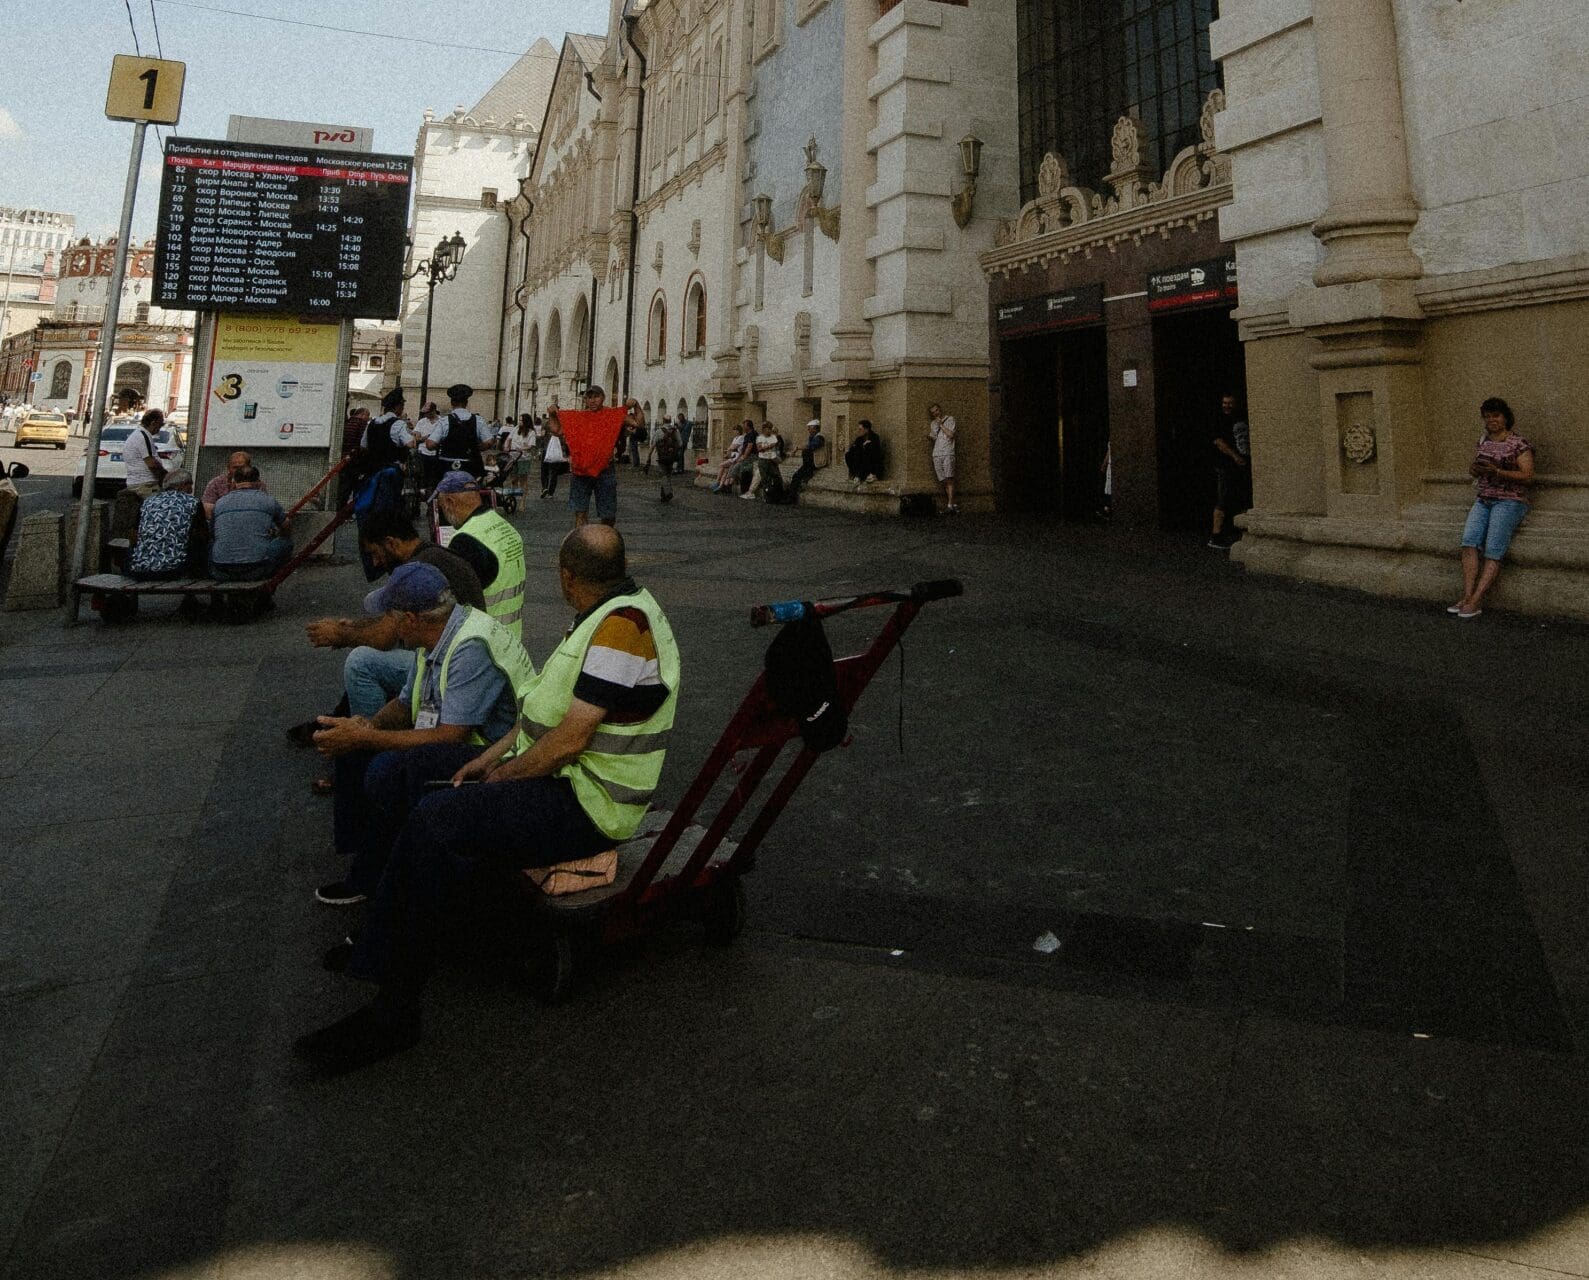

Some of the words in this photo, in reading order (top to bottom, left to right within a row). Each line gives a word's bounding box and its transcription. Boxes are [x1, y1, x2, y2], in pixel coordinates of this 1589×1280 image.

[139, 69, 158, 109] 1
[169, 144, 211, 154] Прибытие
[220, 149, 274, 160] отправление
[275, 153, 308, 162] поездов
[171, 157, 193, 165] Поезд
[223, 161, 255, 170] Маршрут
[256, 164, 296, 172] следования
[322, 168, 341, 177] Приб
[370, 172, 385, 181] Путь
[316, 157, 360, 167] Московское
[362, 162, 385, 170] время
[386, 162, 408, 170] 12:51
[196, 177, 220, 187] фирм
[221, 179, 248, 187] Анапа
[255, 181, 288, 190] Москва
[320, 186, 340, 194] 13:30
[199, 168, 219, 176] скор
[222, 169, 255, 178] Москва
[262, 172, 298, 182] Улан-Удэ
[347, 179, 367, 187] 13:10
[197, 188, 217, 196] скор
[220, 188, 259, 198] Воронеж
[266, 192, 298, 200] Москва
[319, 196, 340, 204] 13:53
[196, 197, 216, 205] скор
[219, 198, 251, 208] Липецк
[258, 200, 290, 209] Москва
[318, 205, 339, 213] 14:10
[169, 214, 184, 222] 119
[194, 217, 214, 225] скор
[217, 217, 252, 226] Саранск
[260, 219, 292, 229] Москва
[316, 223, 337, 232] 14:25
[195, 207, 215, 215] скор
[218, 208, 250, 217] Москва
[258, 210, 290, 220] Липецк
[342, 216, 363, 224] 14:20
[170, 224, 180, 232] 30
[190, 226, 215, 234] фирм
[222, 227, 281, 238] Новороссийск
[341, 235, 362, 243] 14:30
[190, 236, 214, 245] фирм
[215, 236, 248, 245] Москва
[255, 239, 282, 249] Адлер
[340, 244, 361, 252] 14:40
[191, 246, 211, 254] скор
[214, 246, 247, 255] Москва
[254, 249, 296, 258] Феодосия
[339, 253, 360, 261] 14:50
[189, 265, 210, 273] скор
[212, 265, 240, 274] Анапа
[247, 267, 280, 276] Москва
[312, 270, 333, 278] 15:10
[190, 255, 211, 264] скор
[213, 255, 246, 264] Москва
[253, 258, 275, 267] Орск
[338, 262, 359, 271] 15:08
[164, 272, 179, 280] 120
[188, 274, 209, 282] скор
[212, 275, 245, 284] Москва
[252, 277, 287, 286] Саранск
[336, 281, 357, 289] 15:16
[162, 282, 178, 290] 382
[211, 284, 244, 293] Москва
[251, 286, 288, 295] Грозный
[336, 290, 357, 298] 15:34
[161, 292, 177, 300] 233
[187, 294, 207, 302] скор
[210, 294, 237, 303] Адлер
[244, 296, 277, 305] Москва
[309, 298, 331, 307] 16:00
[222, 373, 242, 400] 3
